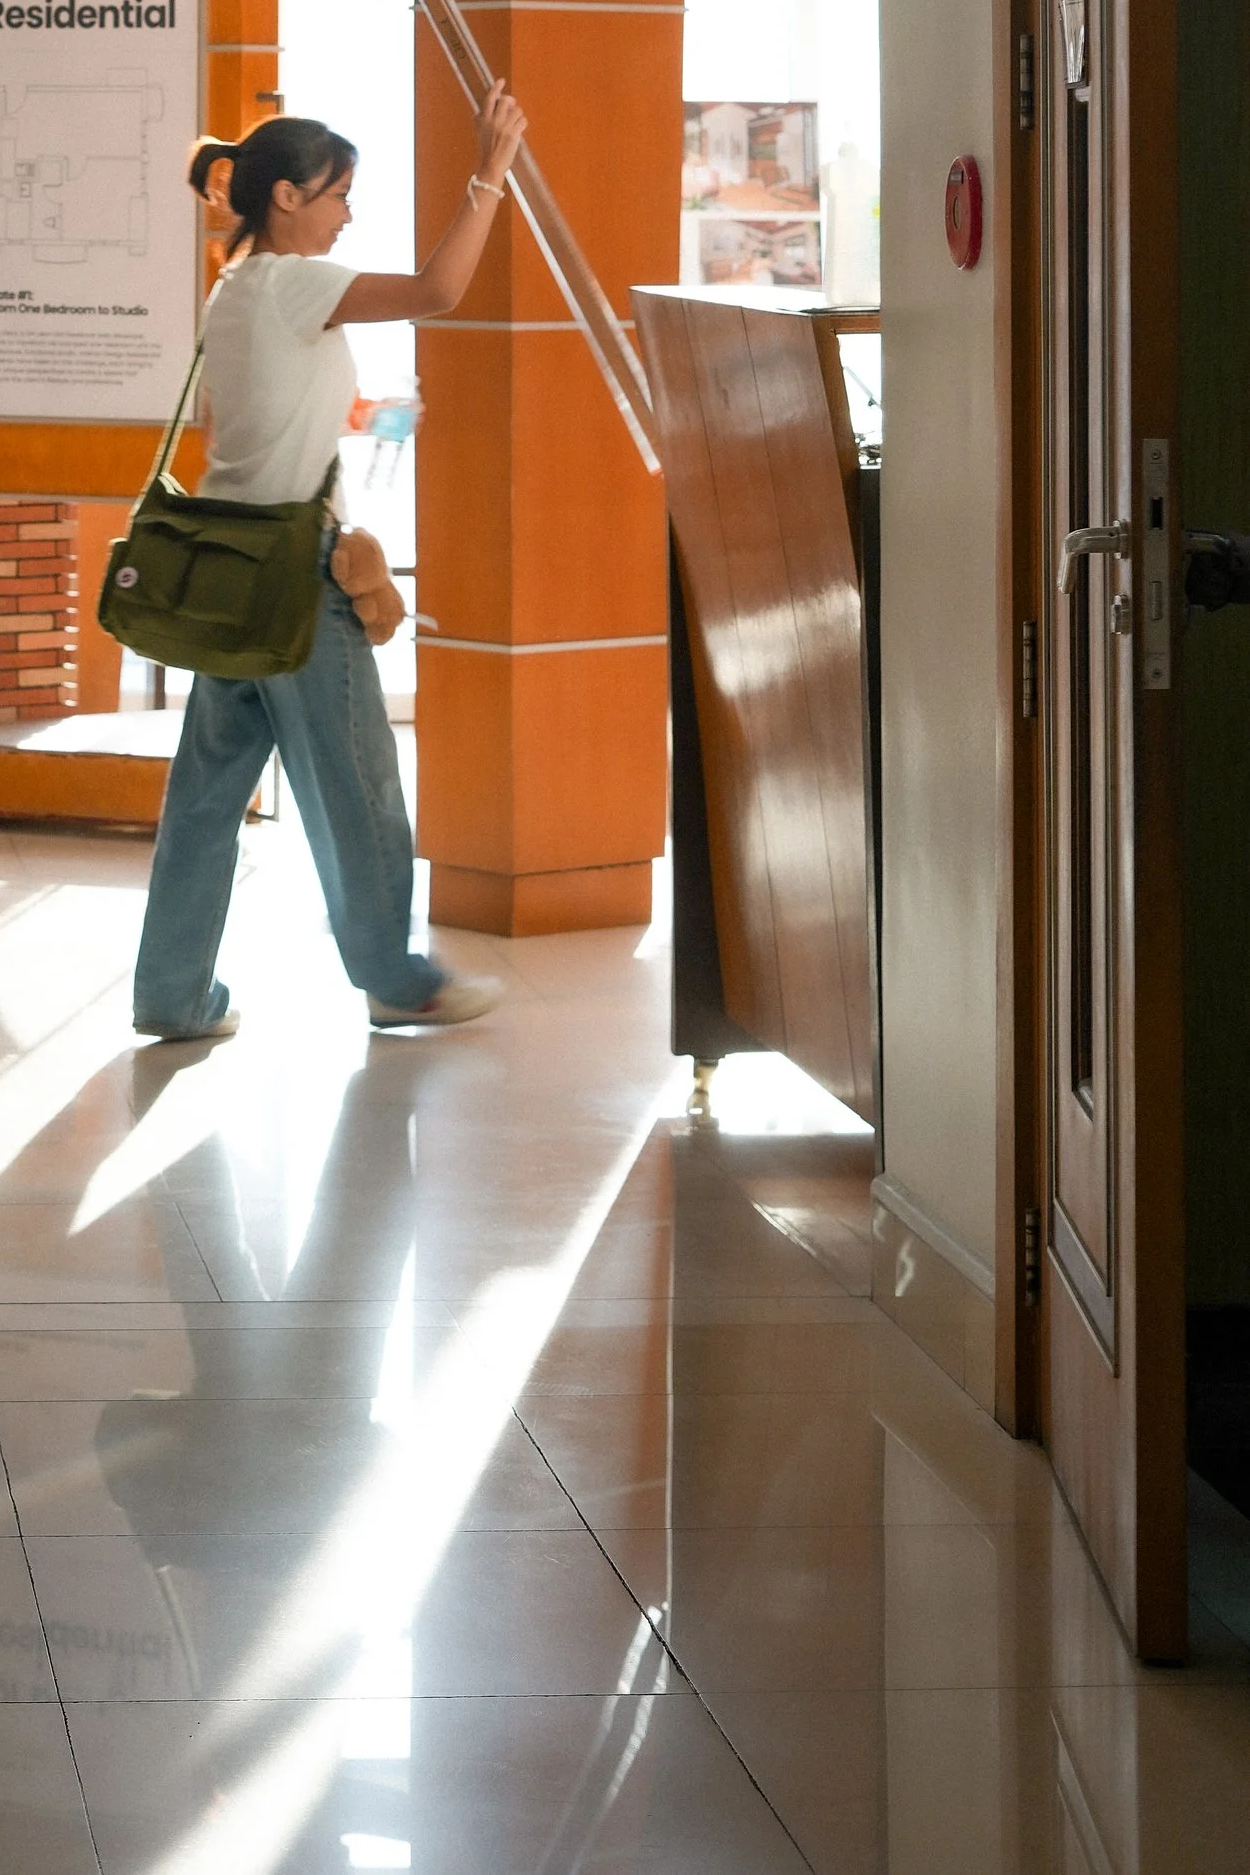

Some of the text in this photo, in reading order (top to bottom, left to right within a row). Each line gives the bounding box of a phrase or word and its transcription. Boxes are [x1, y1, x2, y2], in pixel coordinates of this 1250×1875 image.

[18, 302, 41, 314] One
[42, 303, 96, 315] Bedroom
[97, 304, 110, 316] to
[111, 304, 149, 316] Studio
